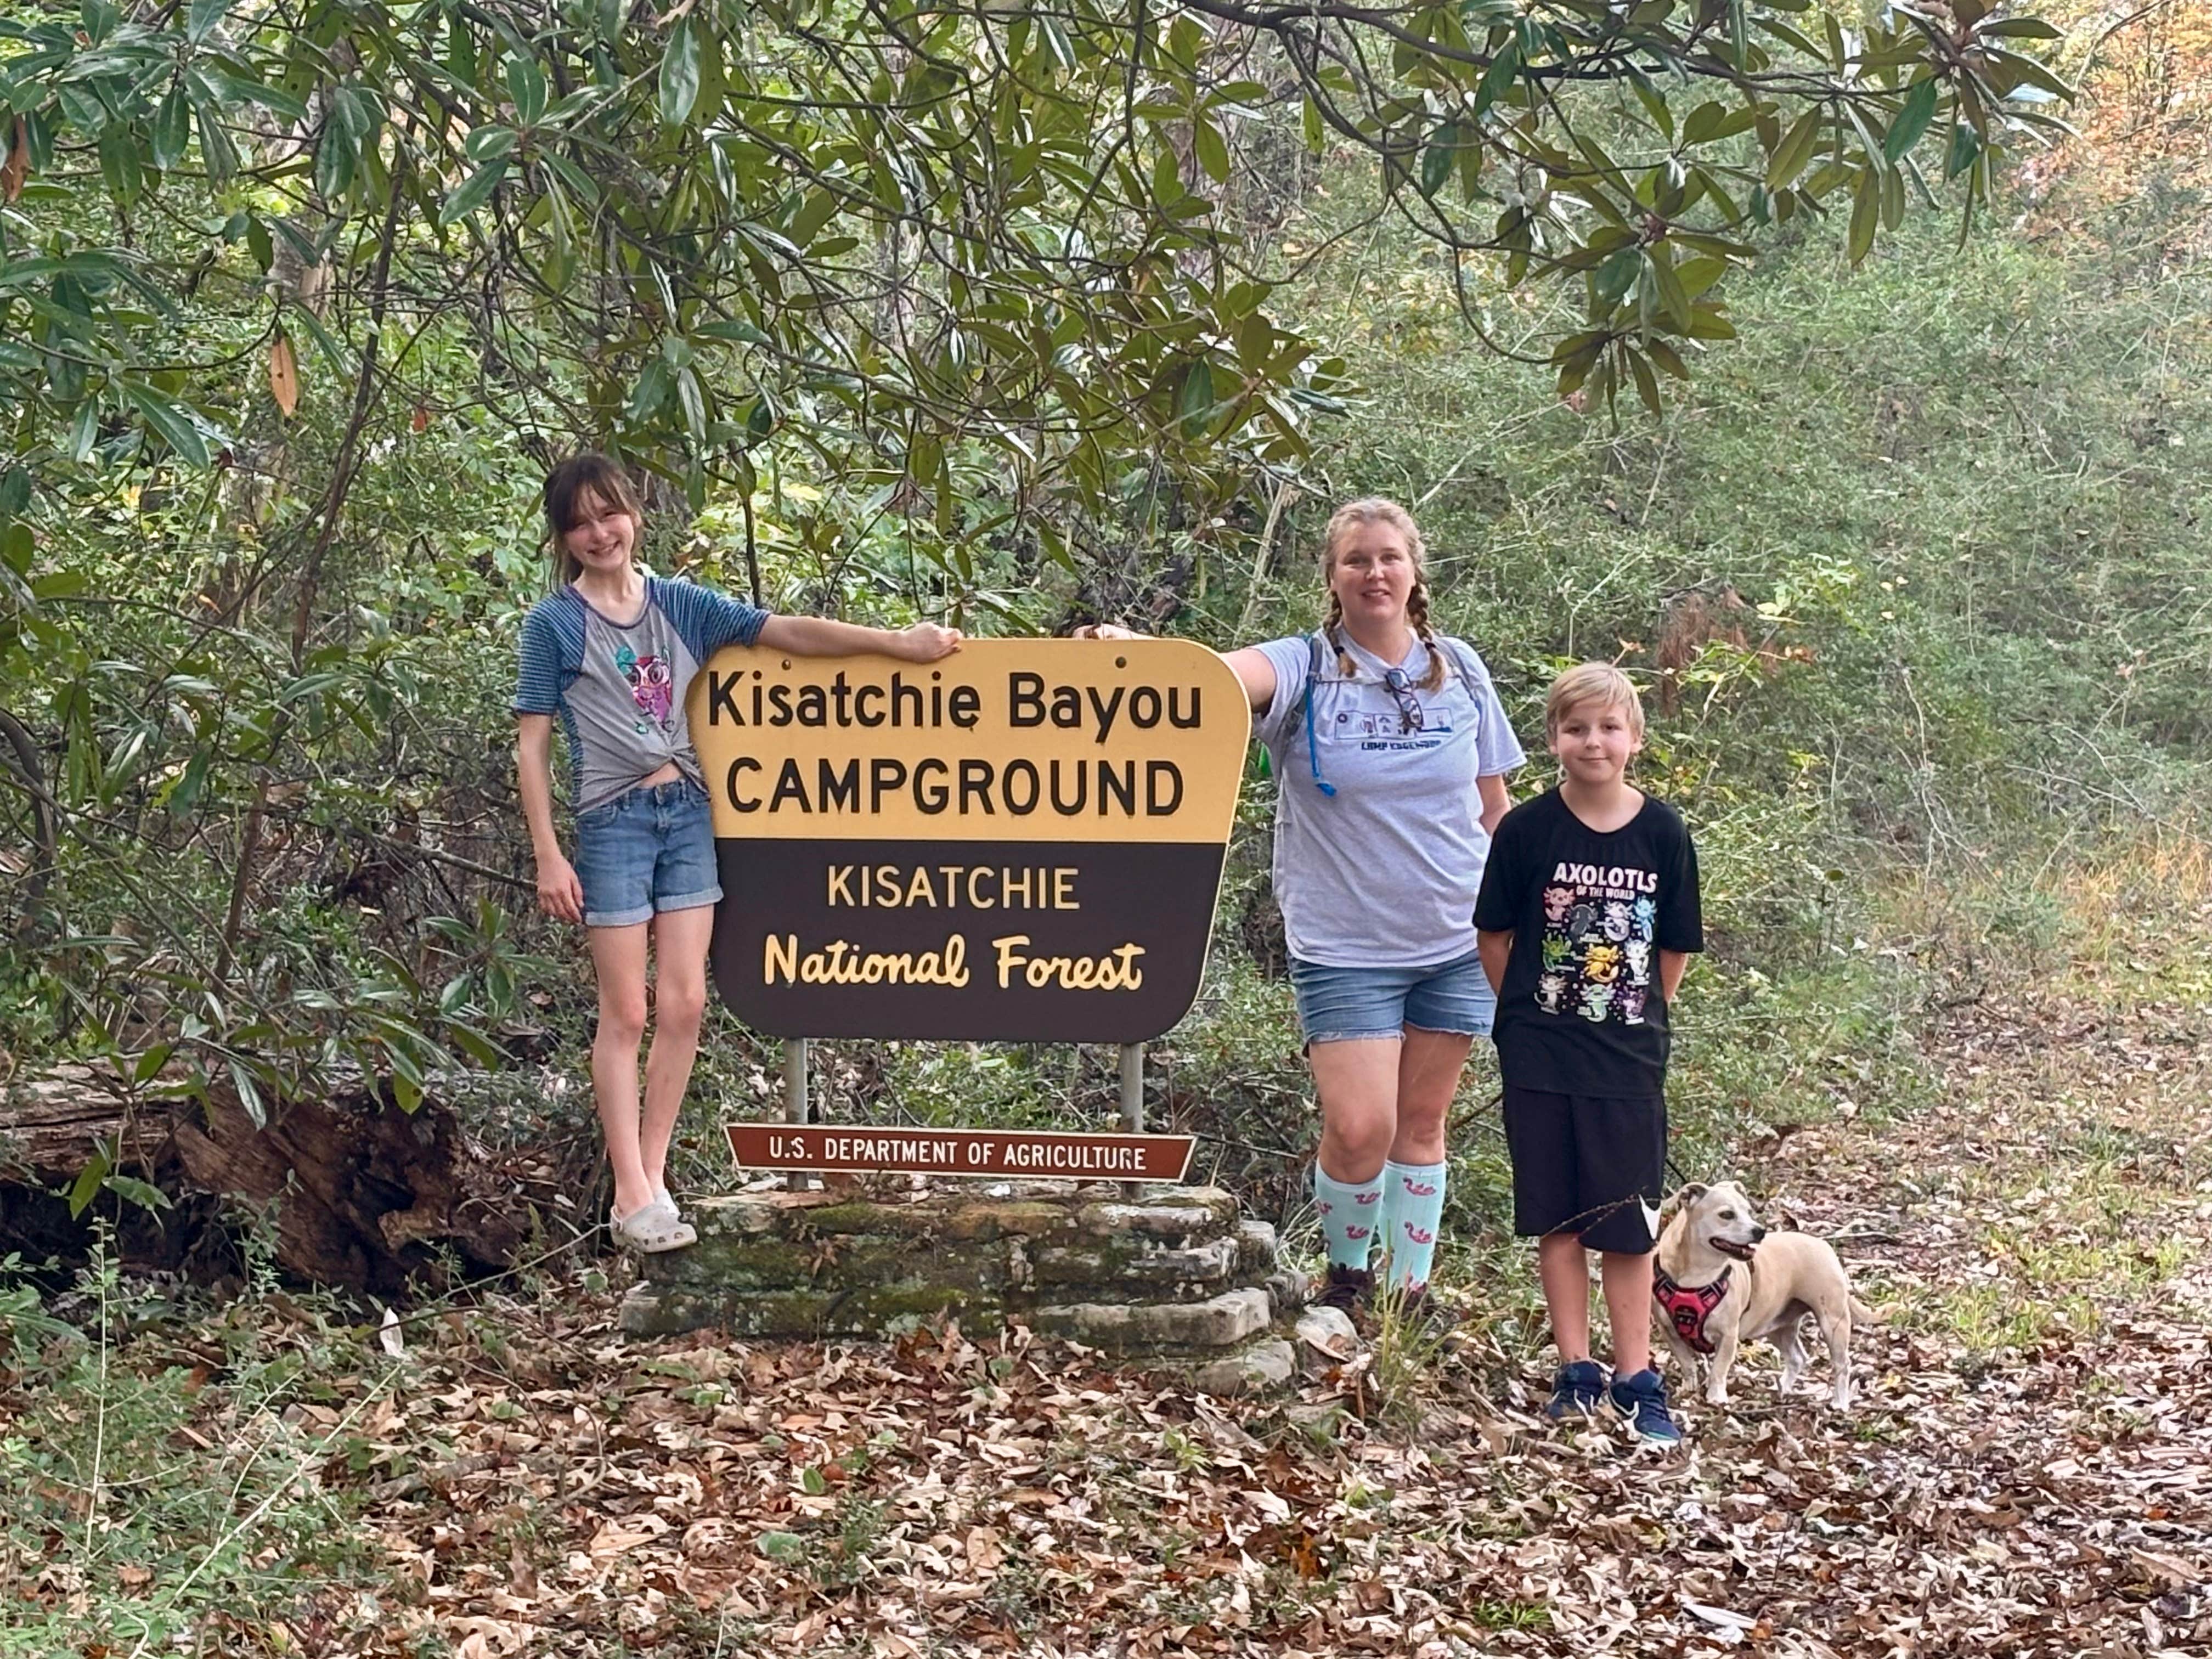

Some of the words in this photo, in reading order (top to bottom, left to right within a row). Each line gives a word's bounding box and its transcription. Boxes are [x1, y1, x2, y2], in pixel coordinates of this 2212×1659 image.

[708, 670, 981, 729] Kisatchie
[1009, 672, 1201, 743] Bayou
[726, 756, 1184, 816] CAMPGROUND
[827, 865, 1081, 910] KISATCHIE
[1553, 862, 1658, 893] AXOLOTLS
[1576, 885, 1587, 895] OF
[1589, 887, 1604, 898] THE
[1605, 887, 1635, 900] WORLD
[764, 934, 969, 988] National
[992, 935, 1147, 991] Forest
[769, 1136, 813, 1159] U.S.
[824, 1138, 957, 1164] DEPARTMENT
[968, 1142, 994, 1165] OF
[1003, 1144, 1147, 1170] AGRICULTURE
